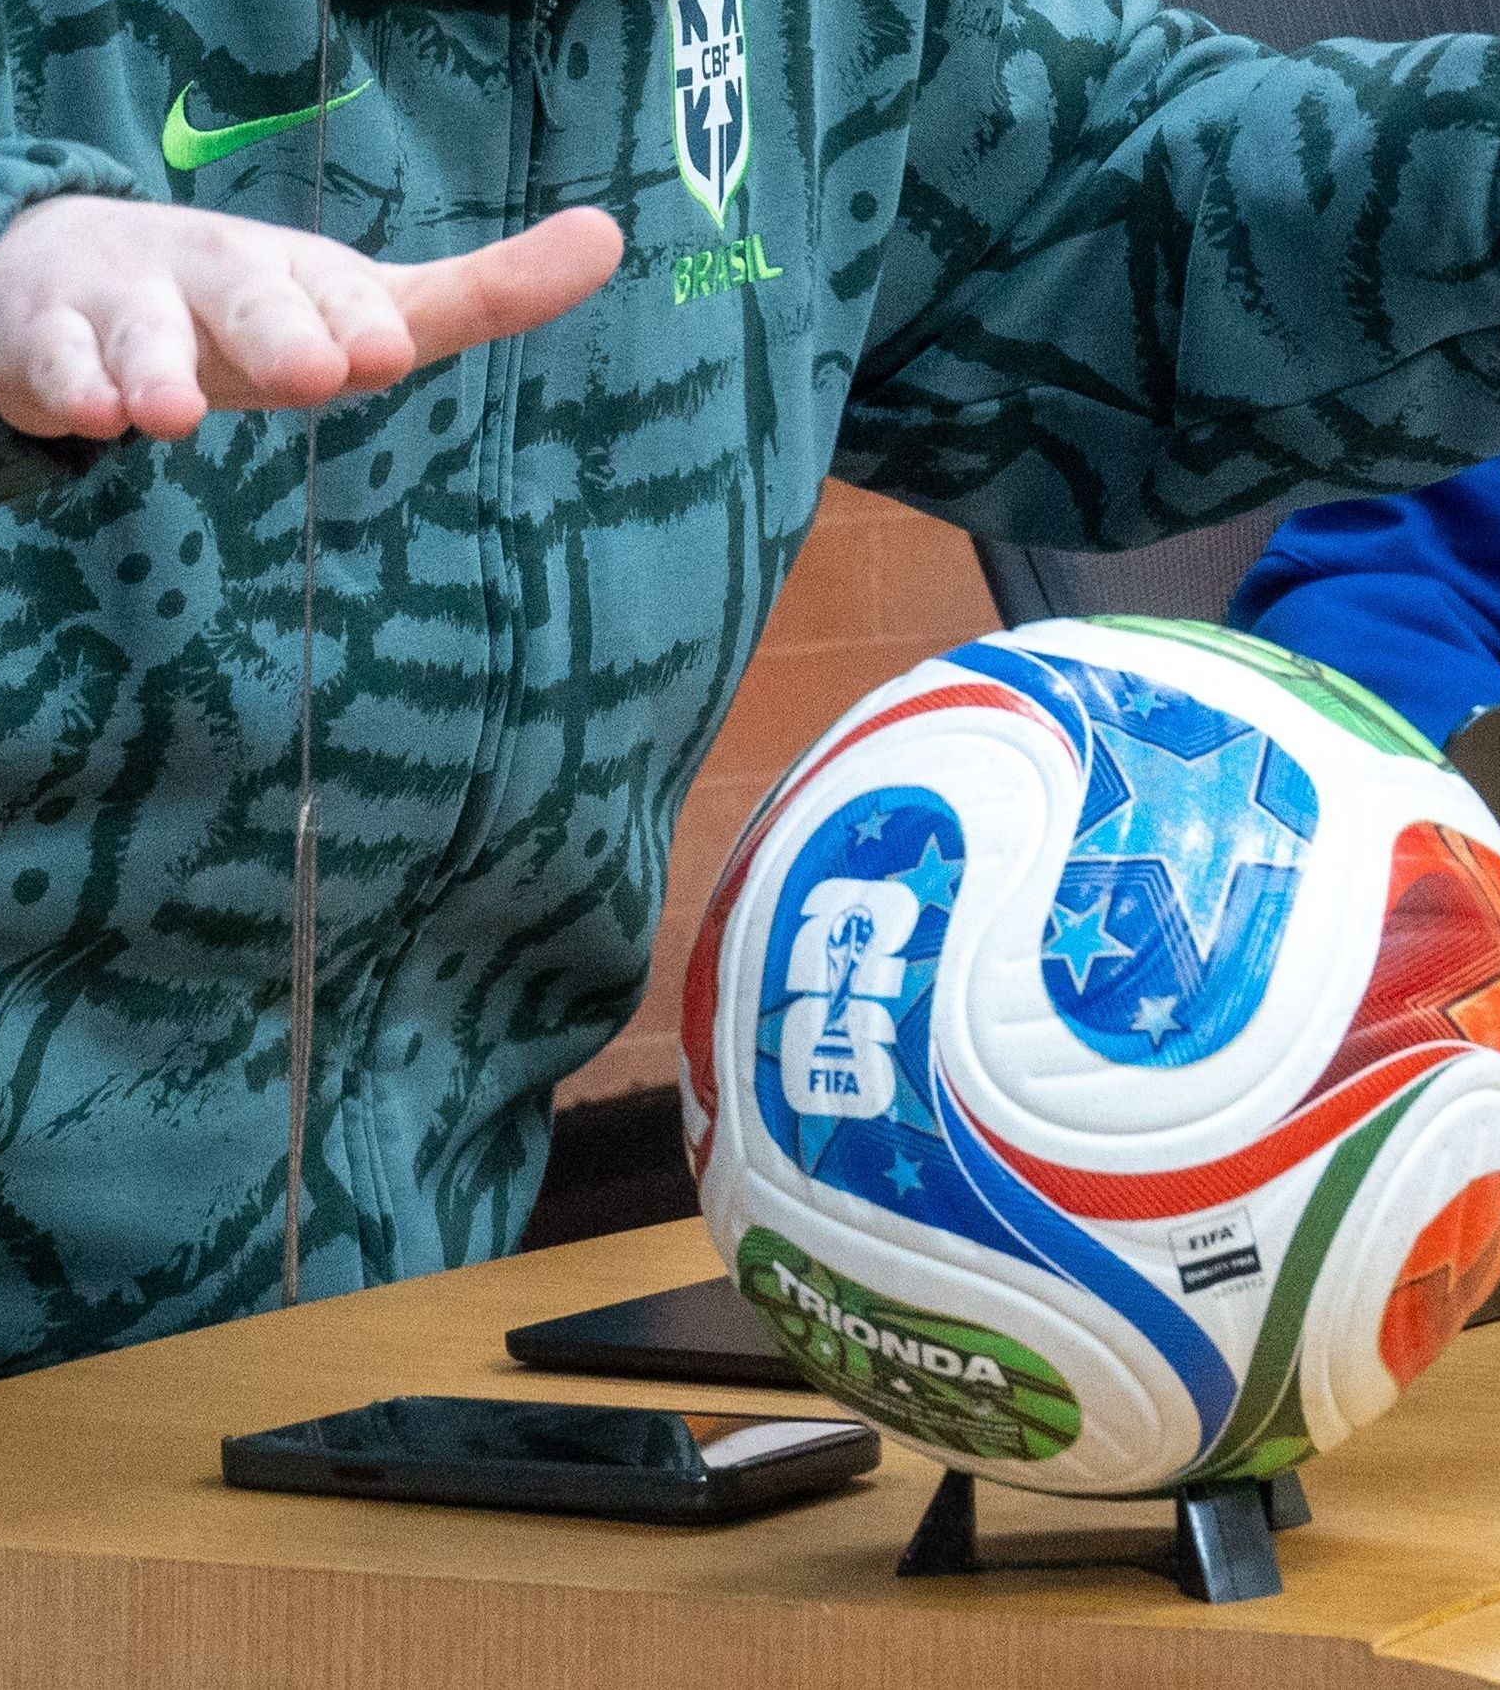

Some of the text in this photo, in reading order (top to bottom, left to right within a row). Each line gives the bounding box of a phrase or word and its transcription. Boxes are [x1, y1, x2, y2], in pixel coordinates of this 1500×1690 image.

[702, 43, 730, 80] CBF
[674, 234, 783, 305] BRASIL
[809, 1069, 860, 1095] FIFA
[1189, 1224, 1234, 1250] FIFA
[772, 1260, 1008, 1387] TRIONDA
